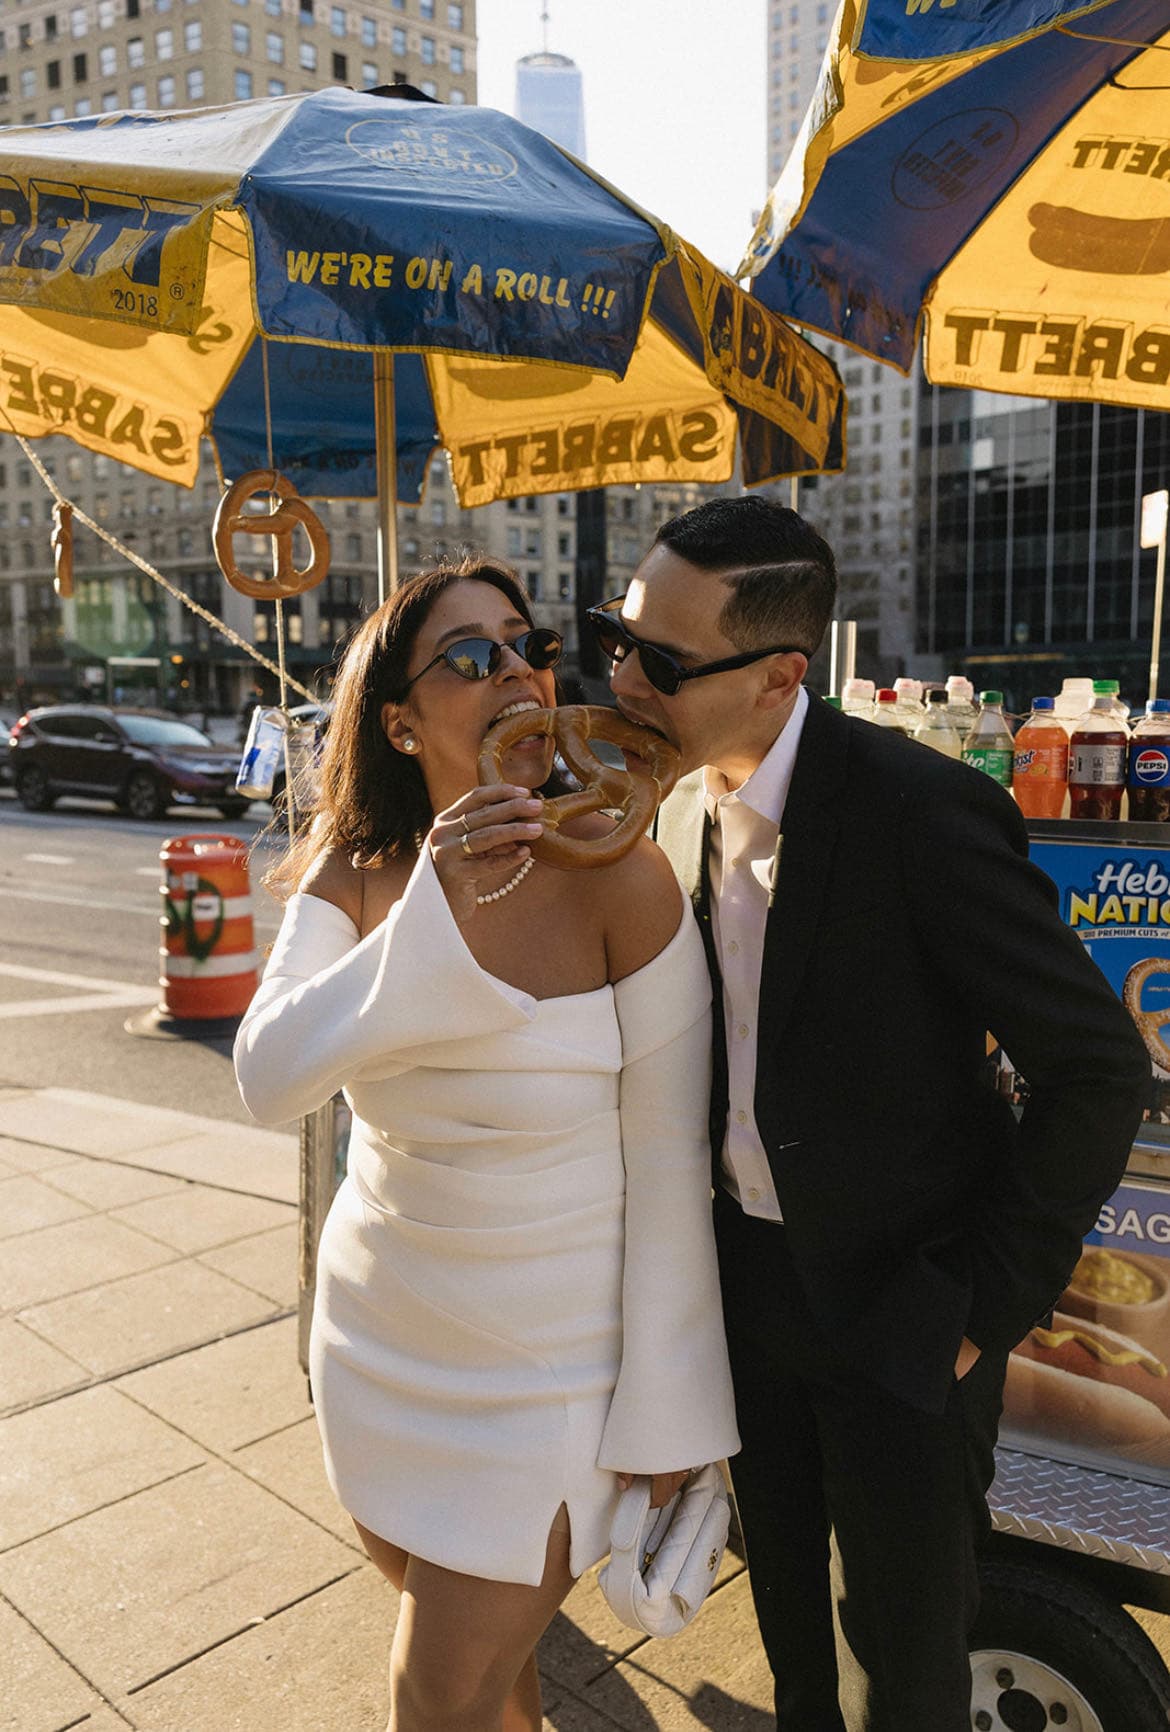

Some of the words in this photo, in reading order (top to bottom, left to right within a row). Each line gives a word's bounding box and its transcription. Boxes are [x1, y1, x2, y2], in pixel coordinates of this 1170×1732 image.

[286, 250, 394, 290] WE'RE
[405, 256, 453, 292] ON
[462, 263, 482, 296] A
[495, 268, 571, 308] ROLL
[114, 288, 158, 317] 2018
[1137, 761, 1167, 770] PEPSI
[1096, 863, 1170, 895] Heb
[1098, 929, 1136, 937] PREMIUM
[1138, 929, 1159, 937] CUTS
[1094, 1204, 1170, 1243] SAG
